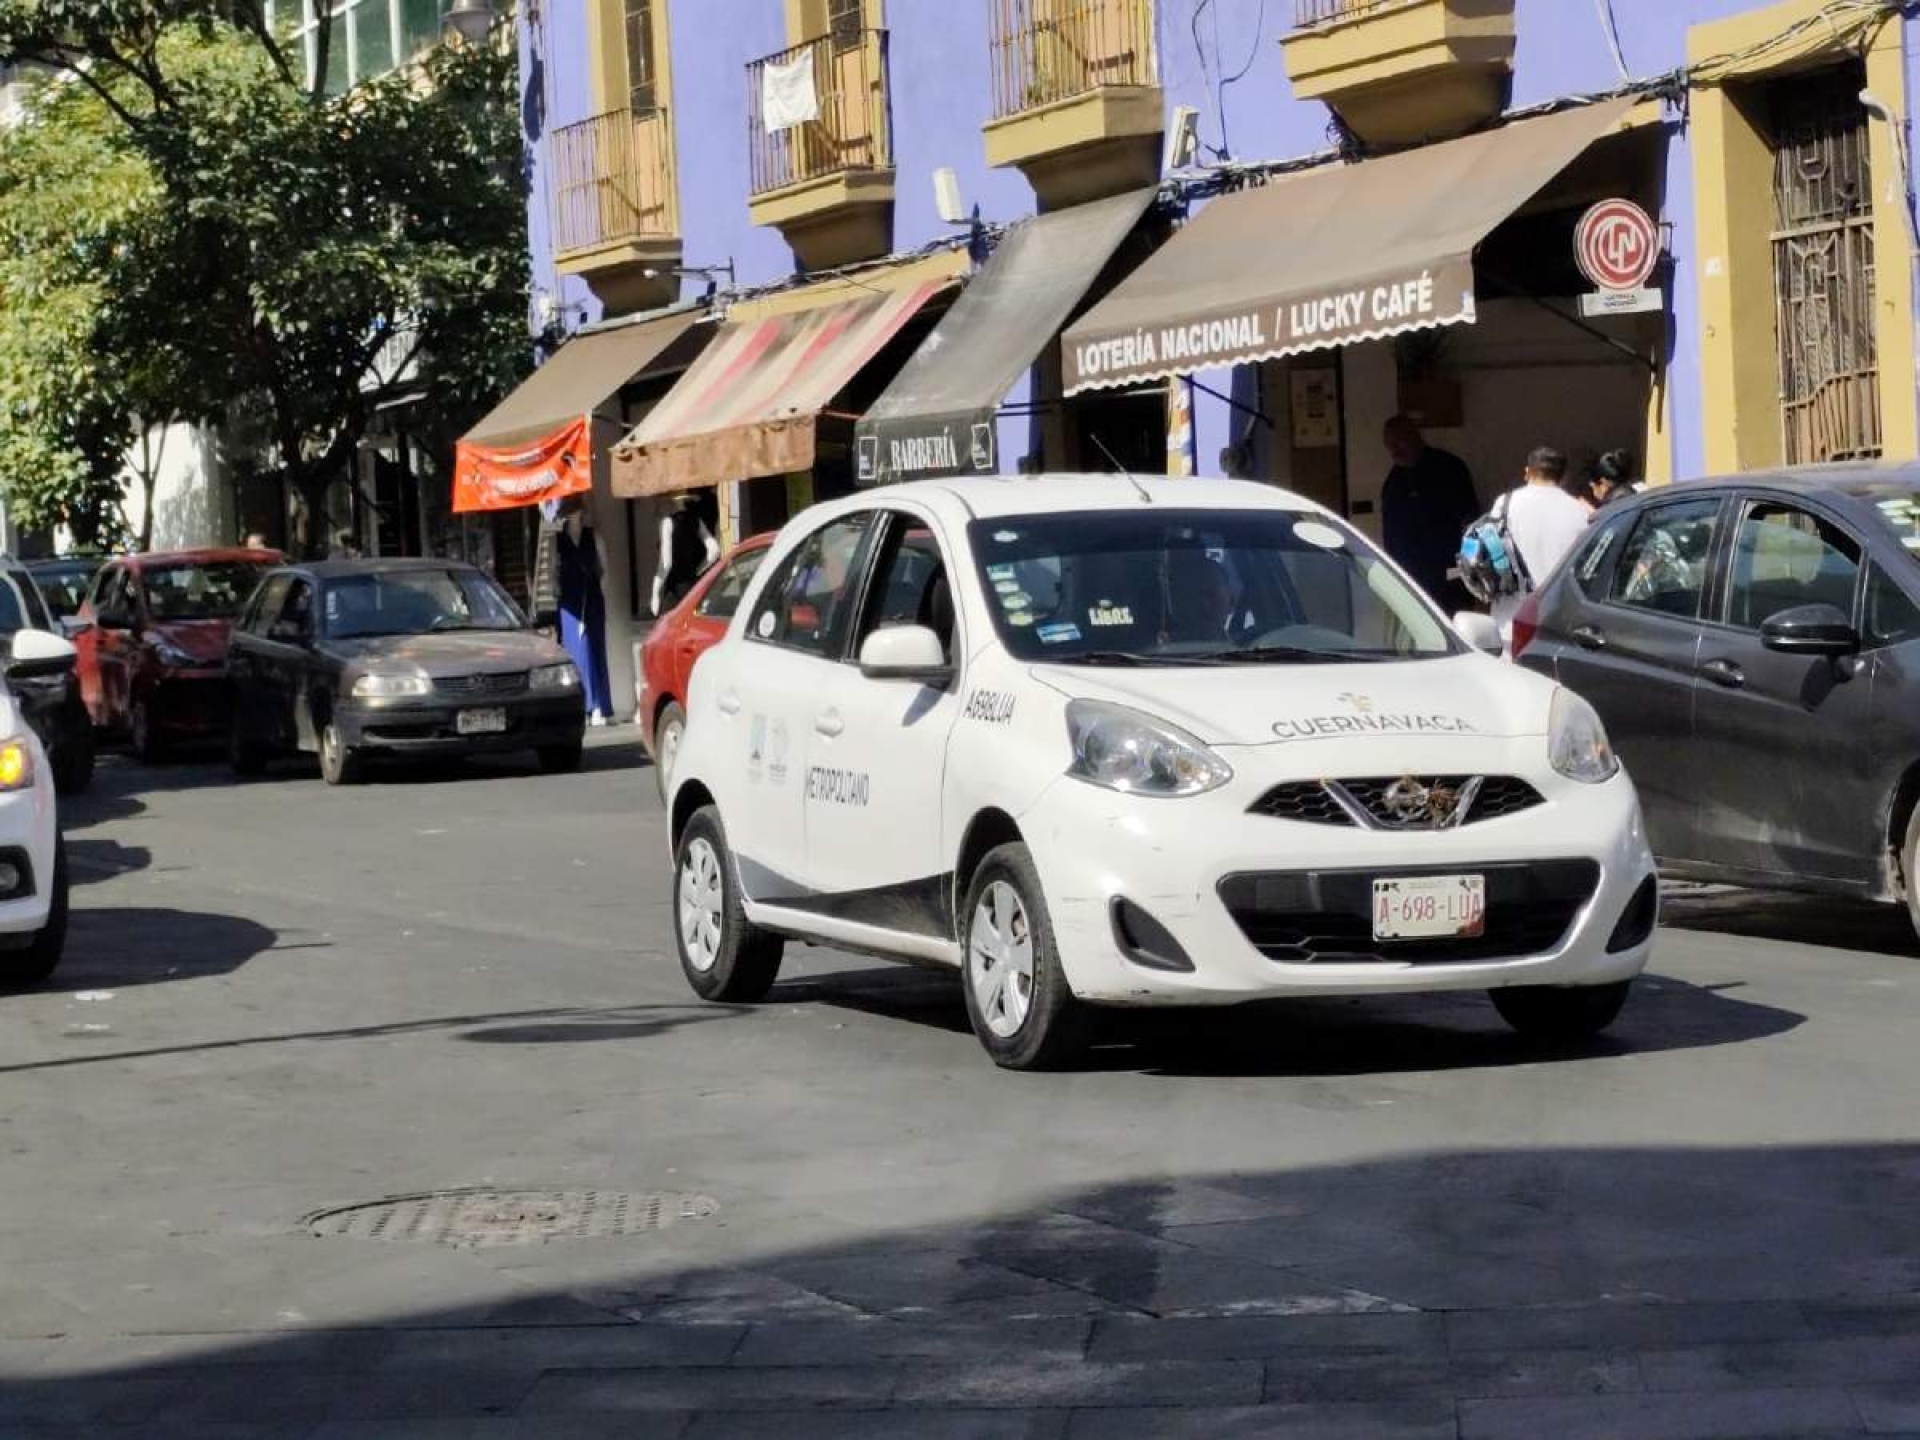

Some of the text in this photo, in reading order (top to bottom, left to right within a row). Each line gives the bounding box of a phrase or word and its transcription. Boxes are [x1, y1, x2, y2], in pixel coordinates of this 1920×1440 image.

[1076, 327, 1156, 377] LOTERÍA
[1160, 313, 1265, 361] NACIONAL
[1290, 290, 1366, 337] LUCKY
[1371, 269, 1433, 321] CAFÉ
[890, 426, 958, 471] BARBERÍA
[1271, 714, 1478, 738] CUERNAVACA
[1376, 892, 1481, 923] A-698-LUA
